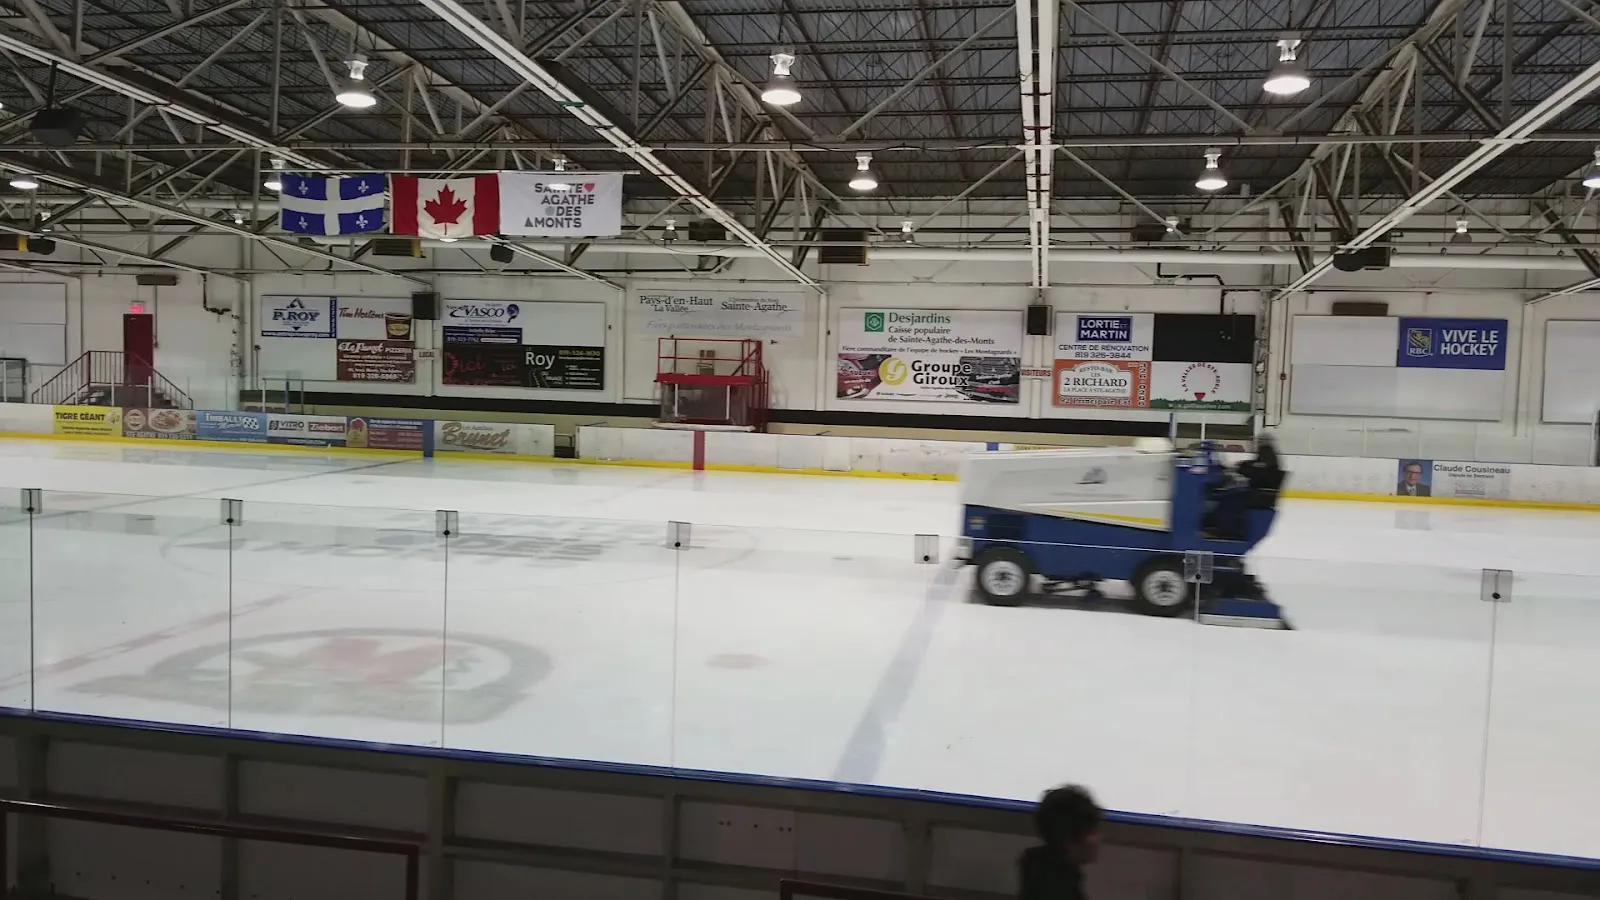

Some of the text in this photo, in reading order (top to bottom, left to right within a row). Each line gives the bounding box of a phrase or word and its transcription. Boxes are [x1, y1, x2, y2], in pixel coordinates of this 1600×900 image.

[534, 183, 583, 193] SATE
[541, 194, 595, 205] AGATHE
[556, 206, 582, 217] DES
[534, 217, 582, 228] MONTS
[640, 296, 788, 312] Pays-d'en-Haut Sainte-Agathe
[338, 307, 385, 319] Tim Hortons
[465, 304, 505, 317] VASCO
[272, 311, 320, 322] P.ROY
[889, 312, 951, 326] Desjardins
[1081, 320, 1119, 329] LORTIE
[888, 326, 951, 336] Caisse populaire
[1081, 330, 1127, 340] MARTIN
[1442, 329, 1499, 344] VIVE LE
[888, 335, 995, 346] de Sainte-Agathe-des-Monts
[1101, 344, 1149, 352] RÉNOVATION
[1409, 347, 1429, 355] RBC
[1440, 343, 1498, 356] HOCKEY
[525, 351, 556, 369] Roy
[911, 360, 971, 376] Groupe
[913, 372, 969, 386] Giroux
[1064, 378, 1128, 387] 2 RICHARD
[1073, 397, 1115, 406] Principale
[56, 411, 106, 421] TIGRE GÉANT
[279, 420, 344, 431] VITRO Ziebart
[442, 421, 512, 447] Brunet
[1433, 464, 1511, 474] Claude Cousineau
